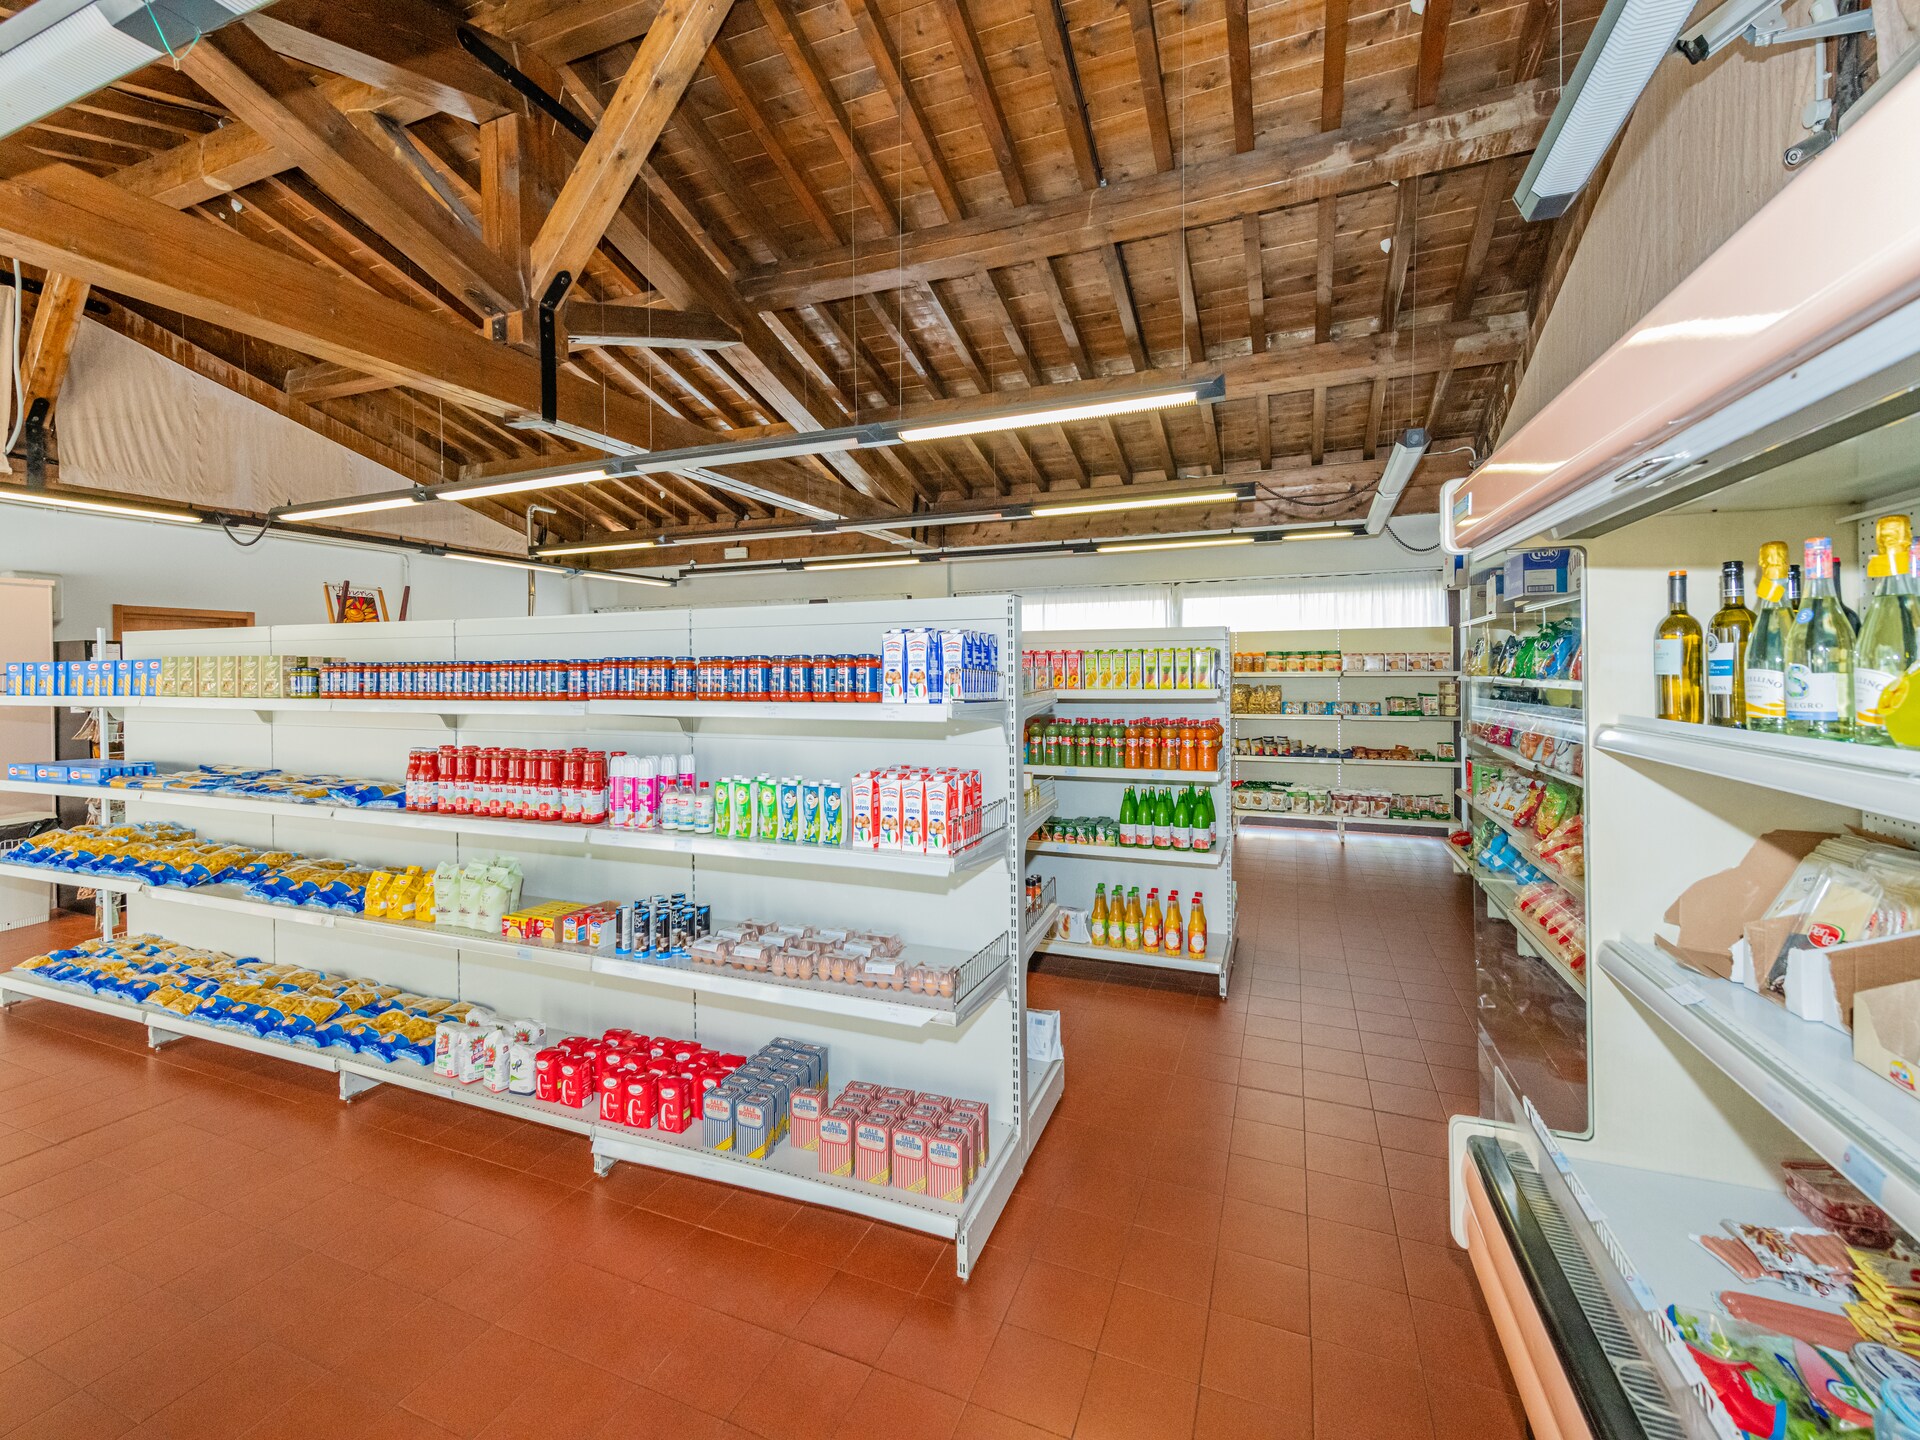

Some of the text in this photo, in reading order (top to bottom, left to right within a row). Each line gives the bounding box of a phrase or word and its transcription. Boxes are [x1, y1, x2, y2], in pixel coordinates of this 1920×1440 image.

[1799, 612, 1807, 620] S
[1786, 665, 1809, 698] S
[882, 805, 897, 813] intero
[905, 807, 920, 815] intero
[929, 808, 944, 816] intero
[537, 1074, 549, 1099] C
[562, 1079, 573, 1105] C
[602, 1092, 615, 1119] C
[798, 1098, 812, 1106] SALE
[628, 1098, 642, 1126] C
[706, 1104, 728, 1113] NOSTRUM
[743, 1105, 756, 1114] SALE
[793, 1103, 818, 1112] NOSTRUM
[661, 1103, 674, 1130] C
[738, 1110, 761, 1121] NOSTRUM
[827, 1121, 842, 1129] SALE
[821, 1125, 847, 1136] NOSTRUM
[864, 1127, 879, 1136] SALE
[858, 1131, 884, 1143] NOSTRUM
[900, 1135, 916, 1143] SALE
[896, 1139, 922, 1151] NOSTRUM
[936, 1143, 951, 1151] SALE
[930, 1147, 958, 1159] NOSTRUM
